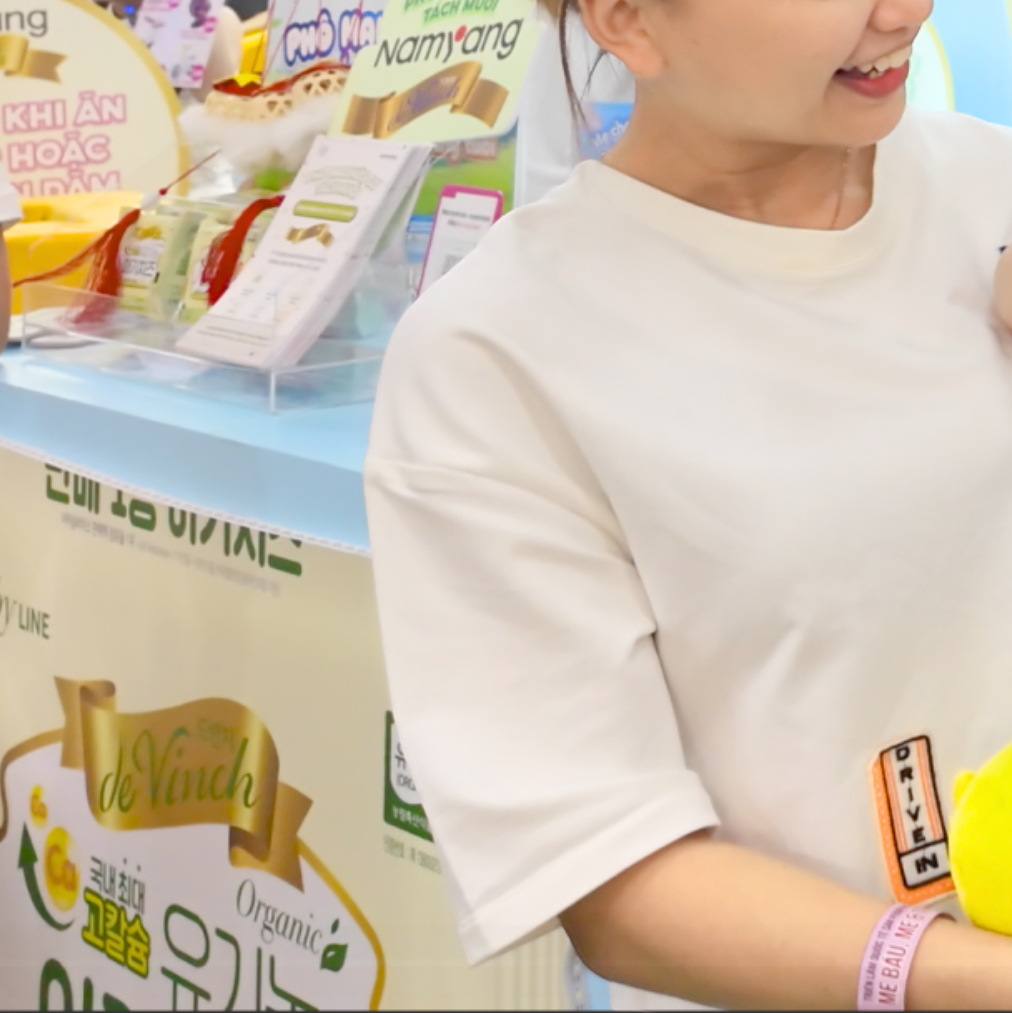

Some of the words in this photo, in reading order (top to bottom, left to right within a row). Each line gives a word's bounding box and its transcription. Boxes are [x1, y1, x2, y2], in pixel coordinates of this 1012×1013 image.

[0, 9, 48, 37] ng
[374, 18, 525, 68] Namyang
[2, 99, 66, 134] KHI
[73, 90, 127, 128] ĂN
[7, 130, 111, 174] HOẶC
[18, 603, 50, 640] LINE
[100, 733, 136, 813] de
[132, 726, 259, 809] Vinch
[894, 744, 927, 845] DRIVE
[914, 852, 940, 876] IN
[81, 886, 151, 979] 고칼슘
[236, 878, 323, 956] Organic
